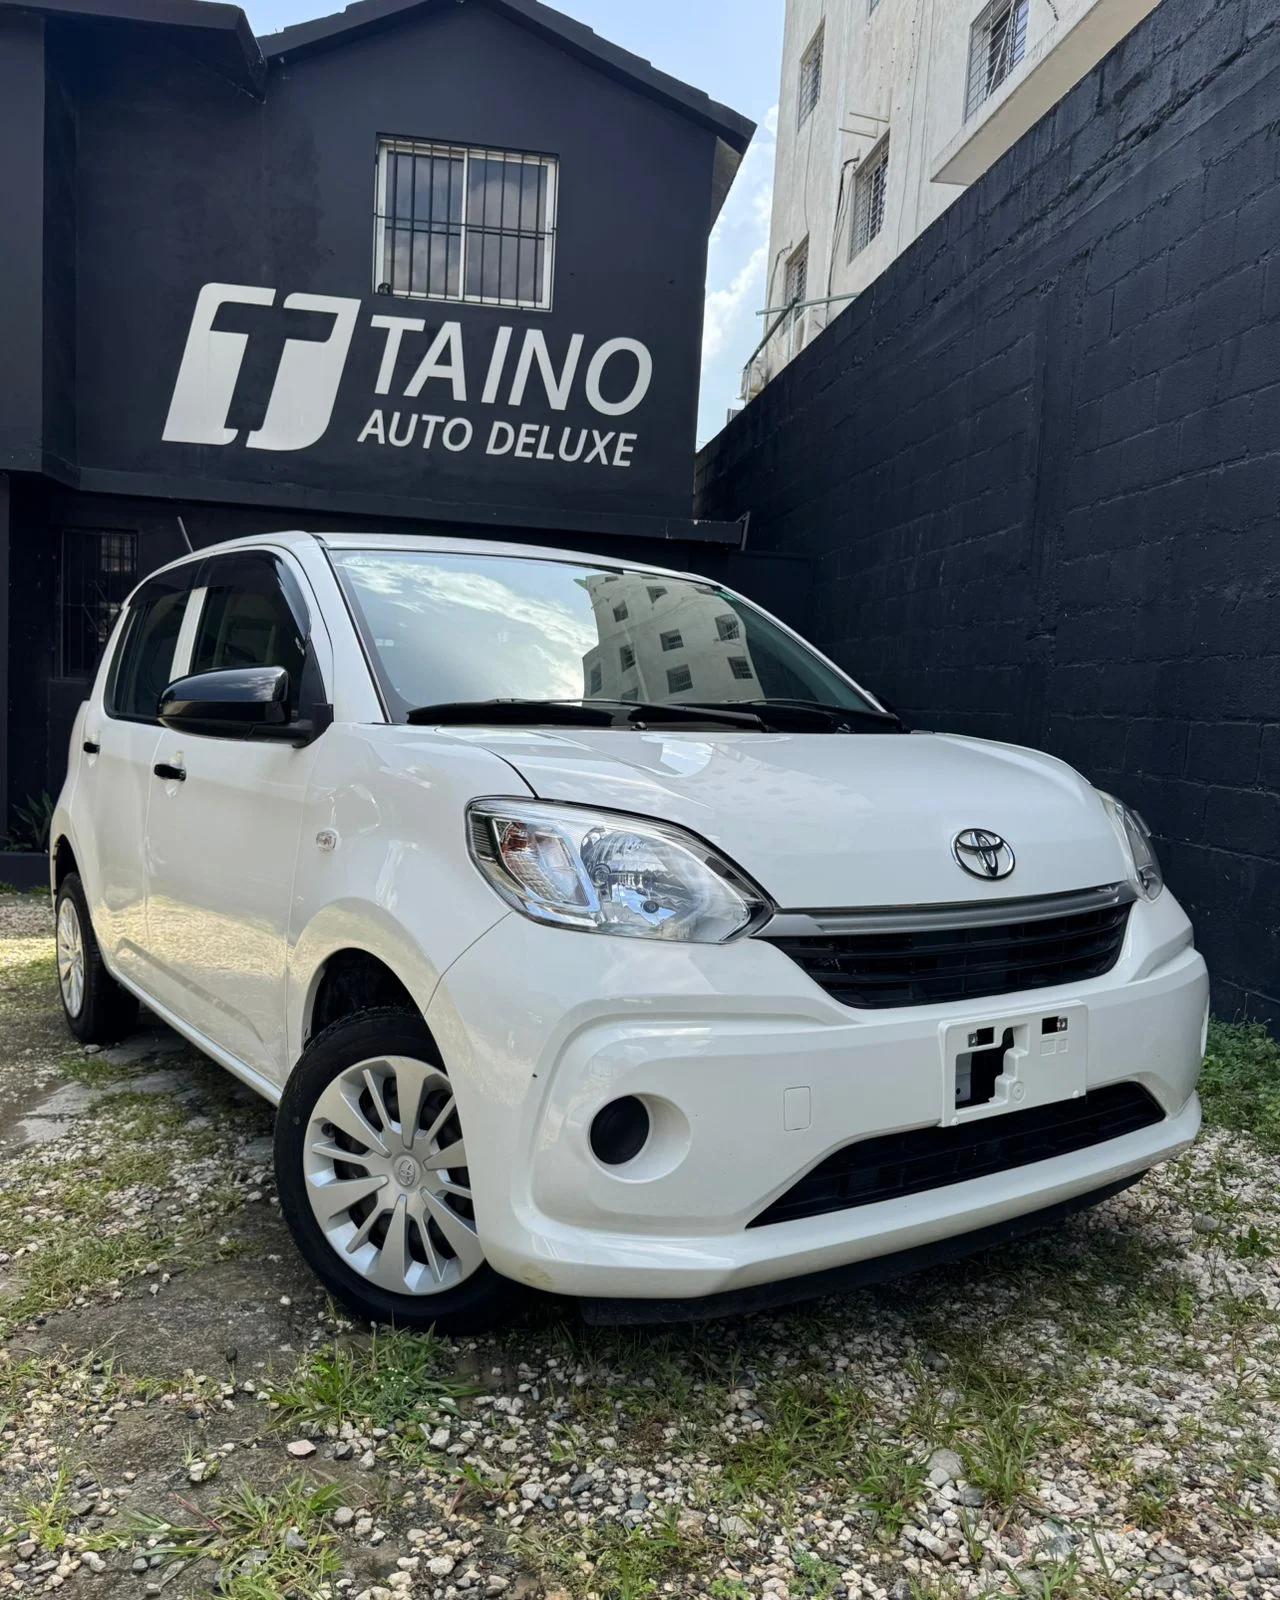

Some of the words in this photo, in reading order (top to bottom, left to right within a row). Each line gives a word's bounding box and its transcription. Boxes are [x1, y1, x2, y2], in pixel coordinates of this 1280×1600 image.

[370, 314, 653, 416] TAINO
[357, 410, 473, 452] AUTO
[485, 421, 638, 467] DELUXE
